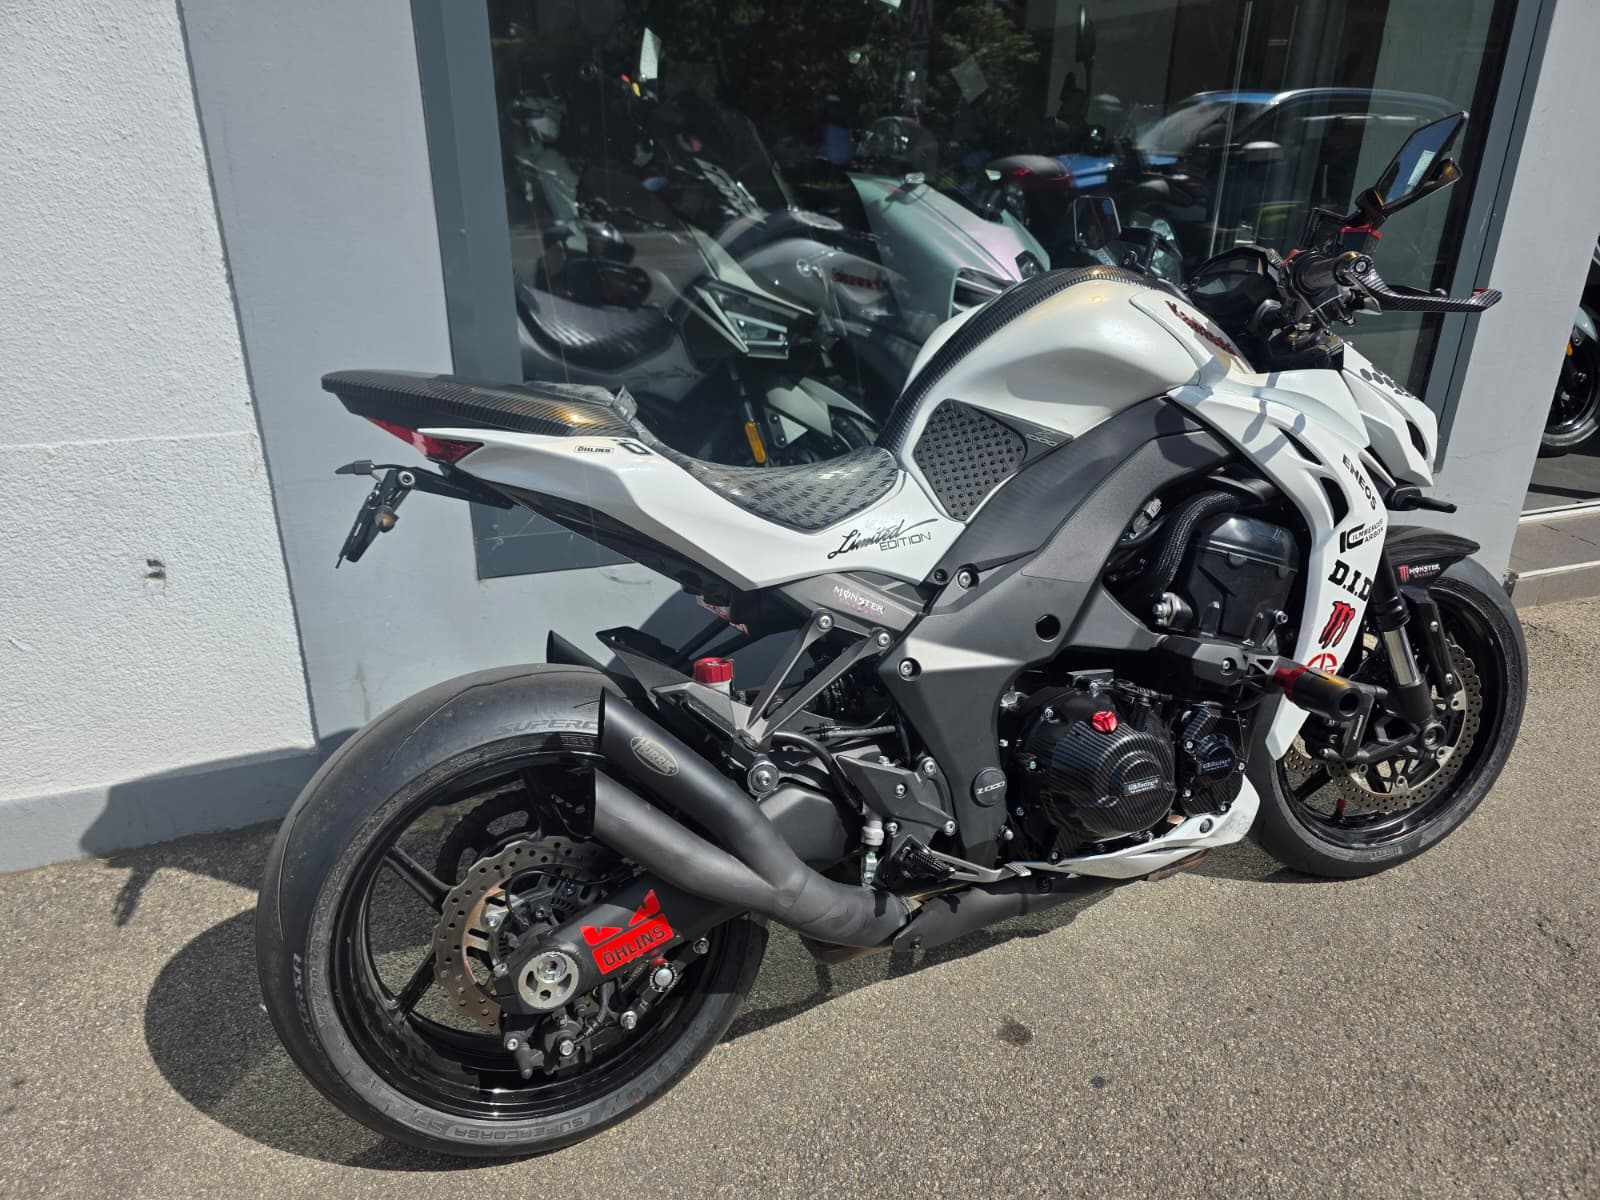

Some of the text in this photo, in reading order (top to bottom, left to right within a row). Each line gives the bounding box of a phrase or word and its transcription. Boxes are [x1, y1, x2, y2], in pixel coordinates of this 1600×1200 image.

[1342, 453, 1377, 511] ENEOS
[827, 518, 938, 559] Limited
[879, 531, 932, 551] EDITION
[833, 586, 885, 615] MONSTER
